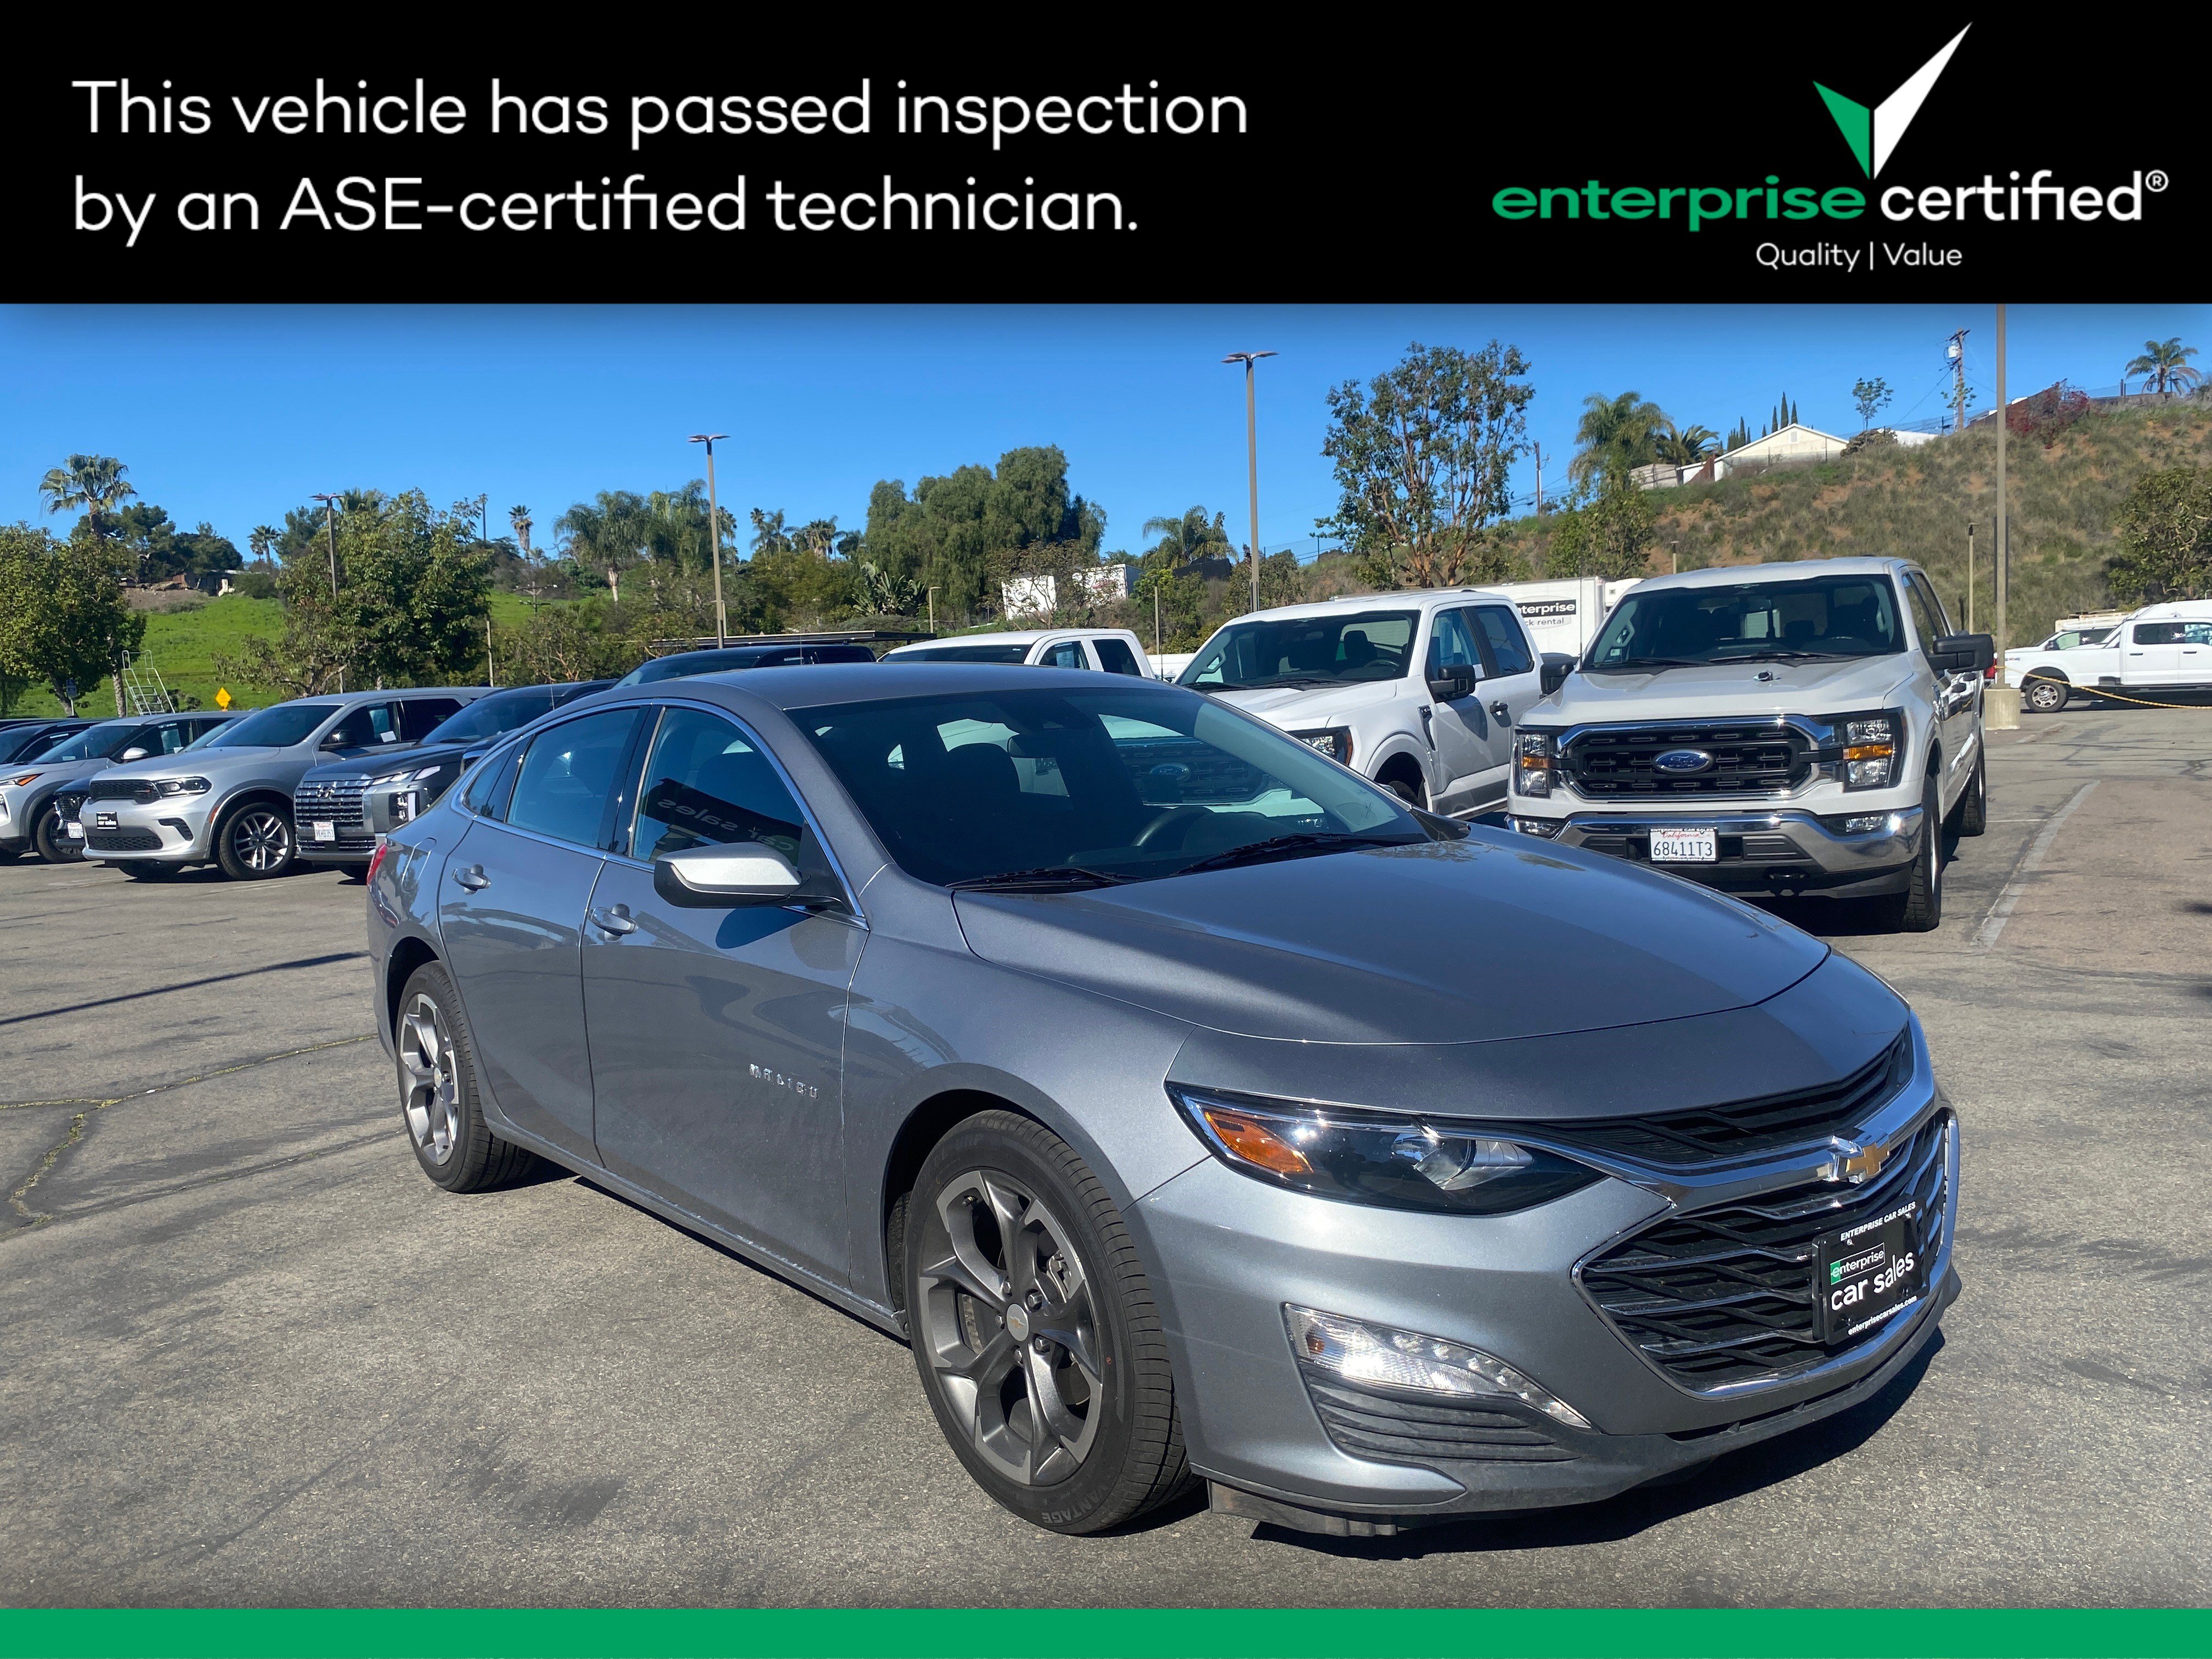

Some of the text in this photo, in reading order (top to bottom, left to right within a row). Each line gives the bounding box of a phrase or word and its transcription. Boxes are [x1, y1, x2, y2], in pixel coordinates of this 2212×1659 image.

[1654, 841, 1712, 856] 68411T3
[1662, 831, 1700, 840] California
[1841, 1201, 1916, 1242] ENTERPRISE CAR SALES
[1831, 1249, 1884, 1278] enterprise
[1831, 1252, 1914, 1311] car sales
[1848, 1295, 1917, 1335] enterprisecarsales.com
